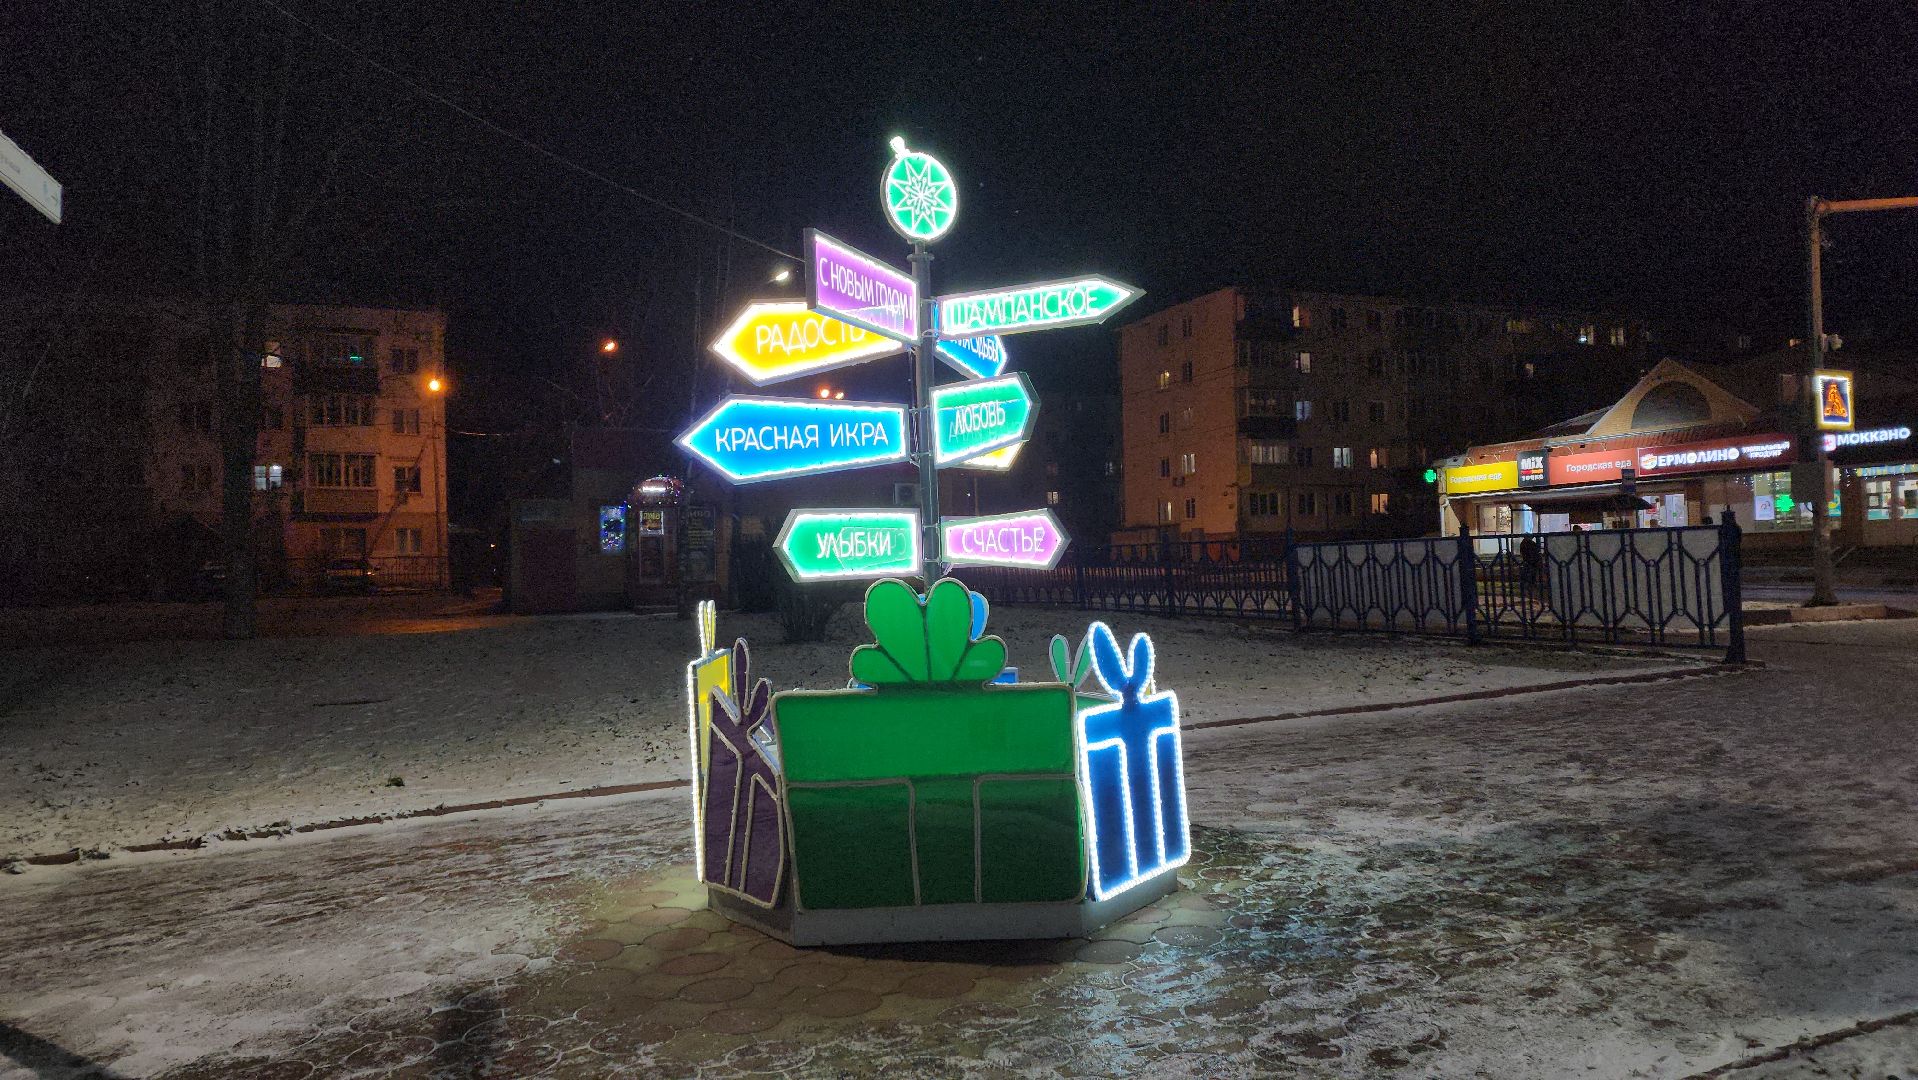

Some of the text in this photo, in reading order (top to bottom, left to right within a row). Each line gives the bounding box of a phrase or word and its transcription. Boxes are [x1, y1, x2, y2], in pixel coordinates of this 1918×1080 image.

[819, 257, 829, 287] С
[830, 261, 875, 306] НОВЫМ
[951, 287, 1099, 326] ШАМПАНСКОЕ
[955, 401, 1006, 435] ЛЮБОВЬ
[715, 422, 889, 452] КРАСНАЯ ИКРА
[1566, 460, 1632, 474] Городская еда
[1657, 447, 1740, 466] ЕРМОЛИНО
[816, 531, 892, 559] УЛЫБКИ
[961, 526, 1046, 552] СЧАСТЬЕ
